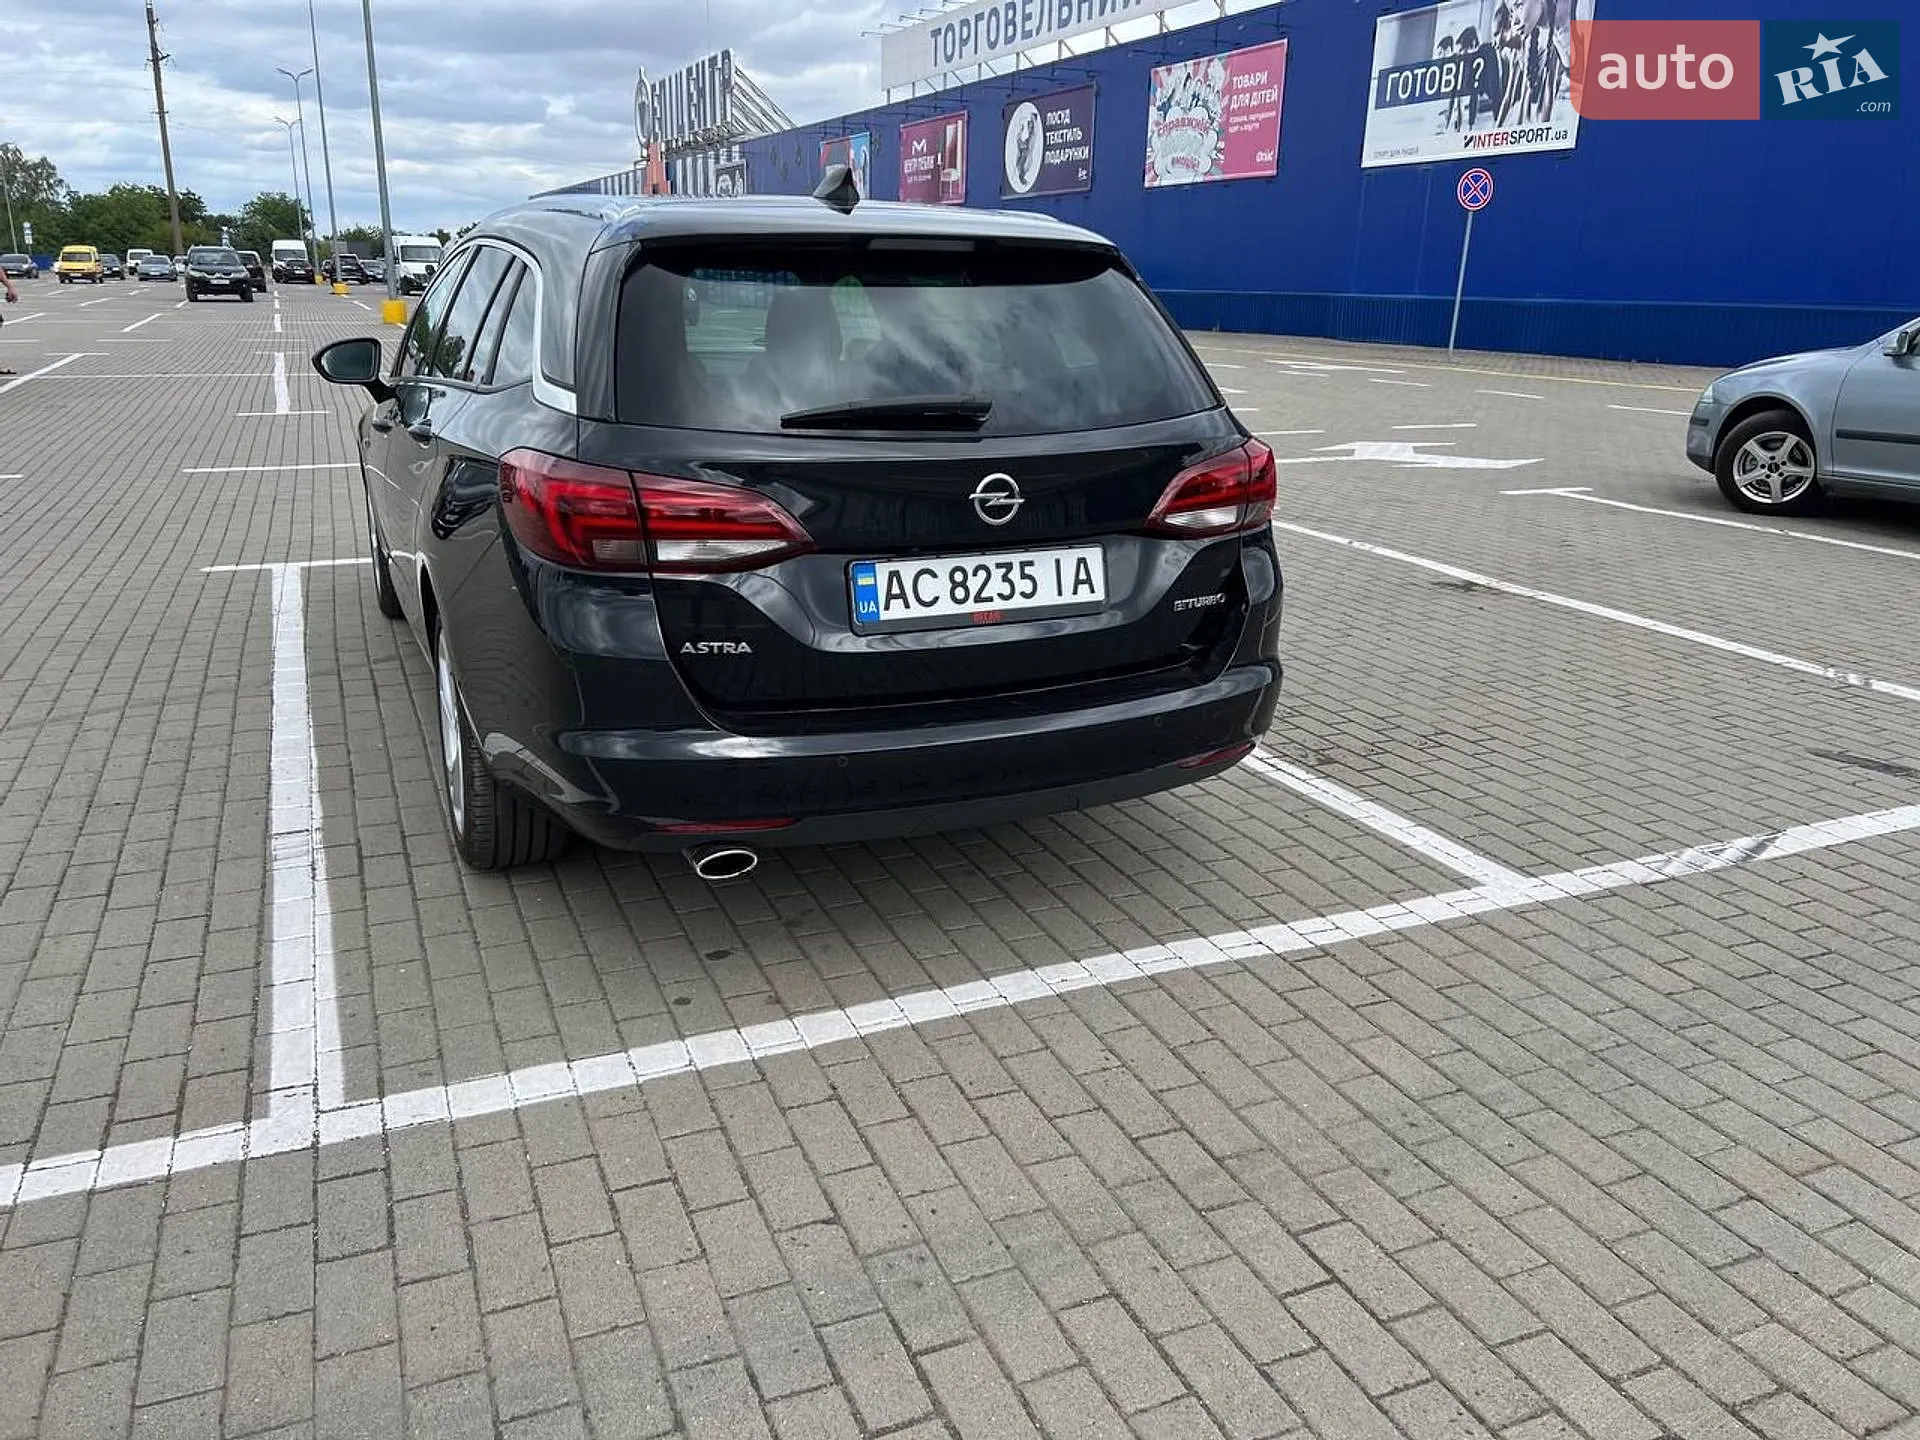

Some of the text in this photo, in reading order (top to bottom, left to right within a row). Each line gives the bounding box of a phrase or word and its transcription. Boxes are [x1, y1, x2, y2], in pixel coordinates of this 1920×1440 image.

[930, 0, 1142, 67] ТОРГОВЕЛЬН
[1232, 70, 1268, 90] ТОВАРИ
[1385, 59, 1484, 102] ГОТОВІ ?
[1045, 127, 1083, 145] ТЕКСТИЛЬ
[1472, 127, 1569, 148] INTERSPORT.ua
[883, 556, 1097, 611] AC 8235 IA
[859, 602, 878, 614] UA
[680, 641, 753, 654] ASTRA
